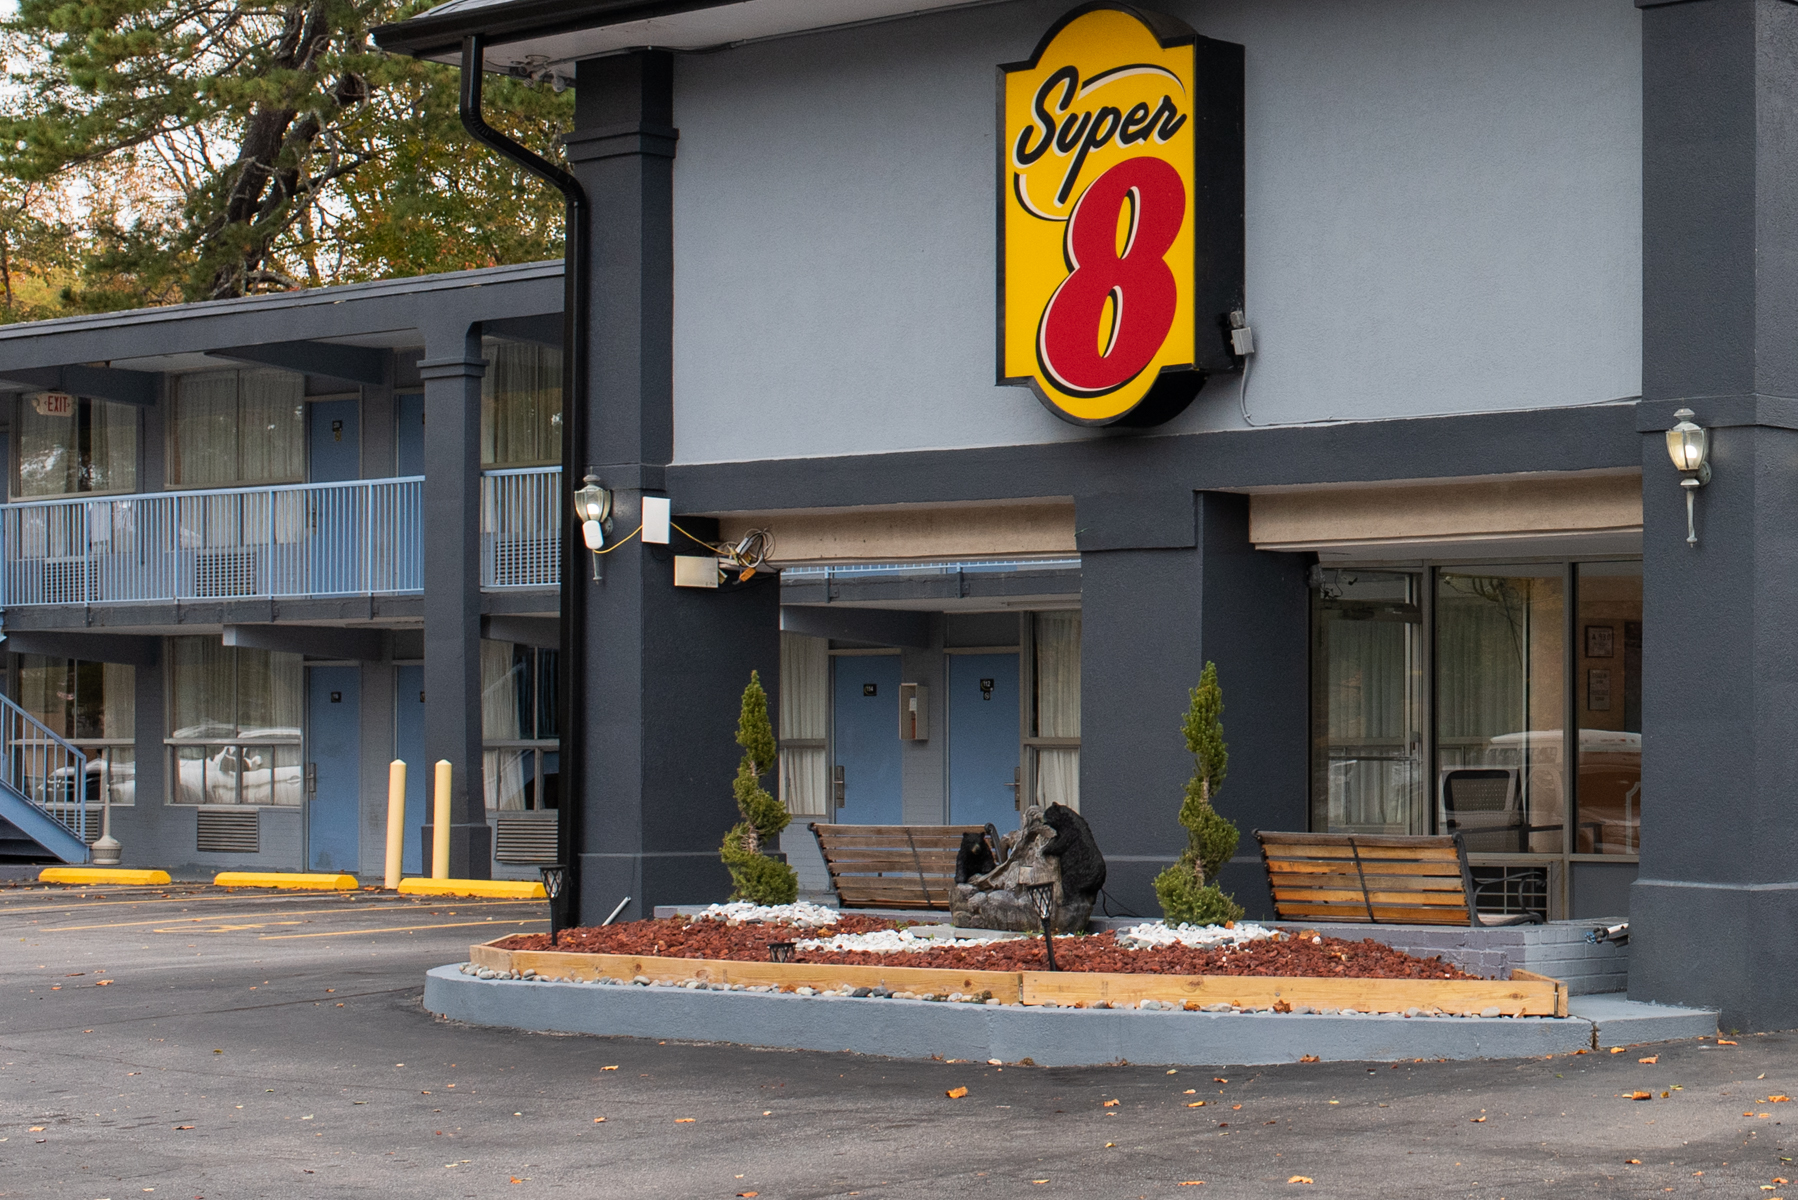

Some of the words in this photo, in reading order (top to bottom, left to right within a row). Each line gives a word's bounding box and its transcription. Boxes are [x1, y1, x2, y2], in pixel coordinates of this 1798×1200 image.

[1013, 64, 1188, 208] Super
[1036, 156, 1186, 397] 8
[47, 395, 68, 413] EXIT
